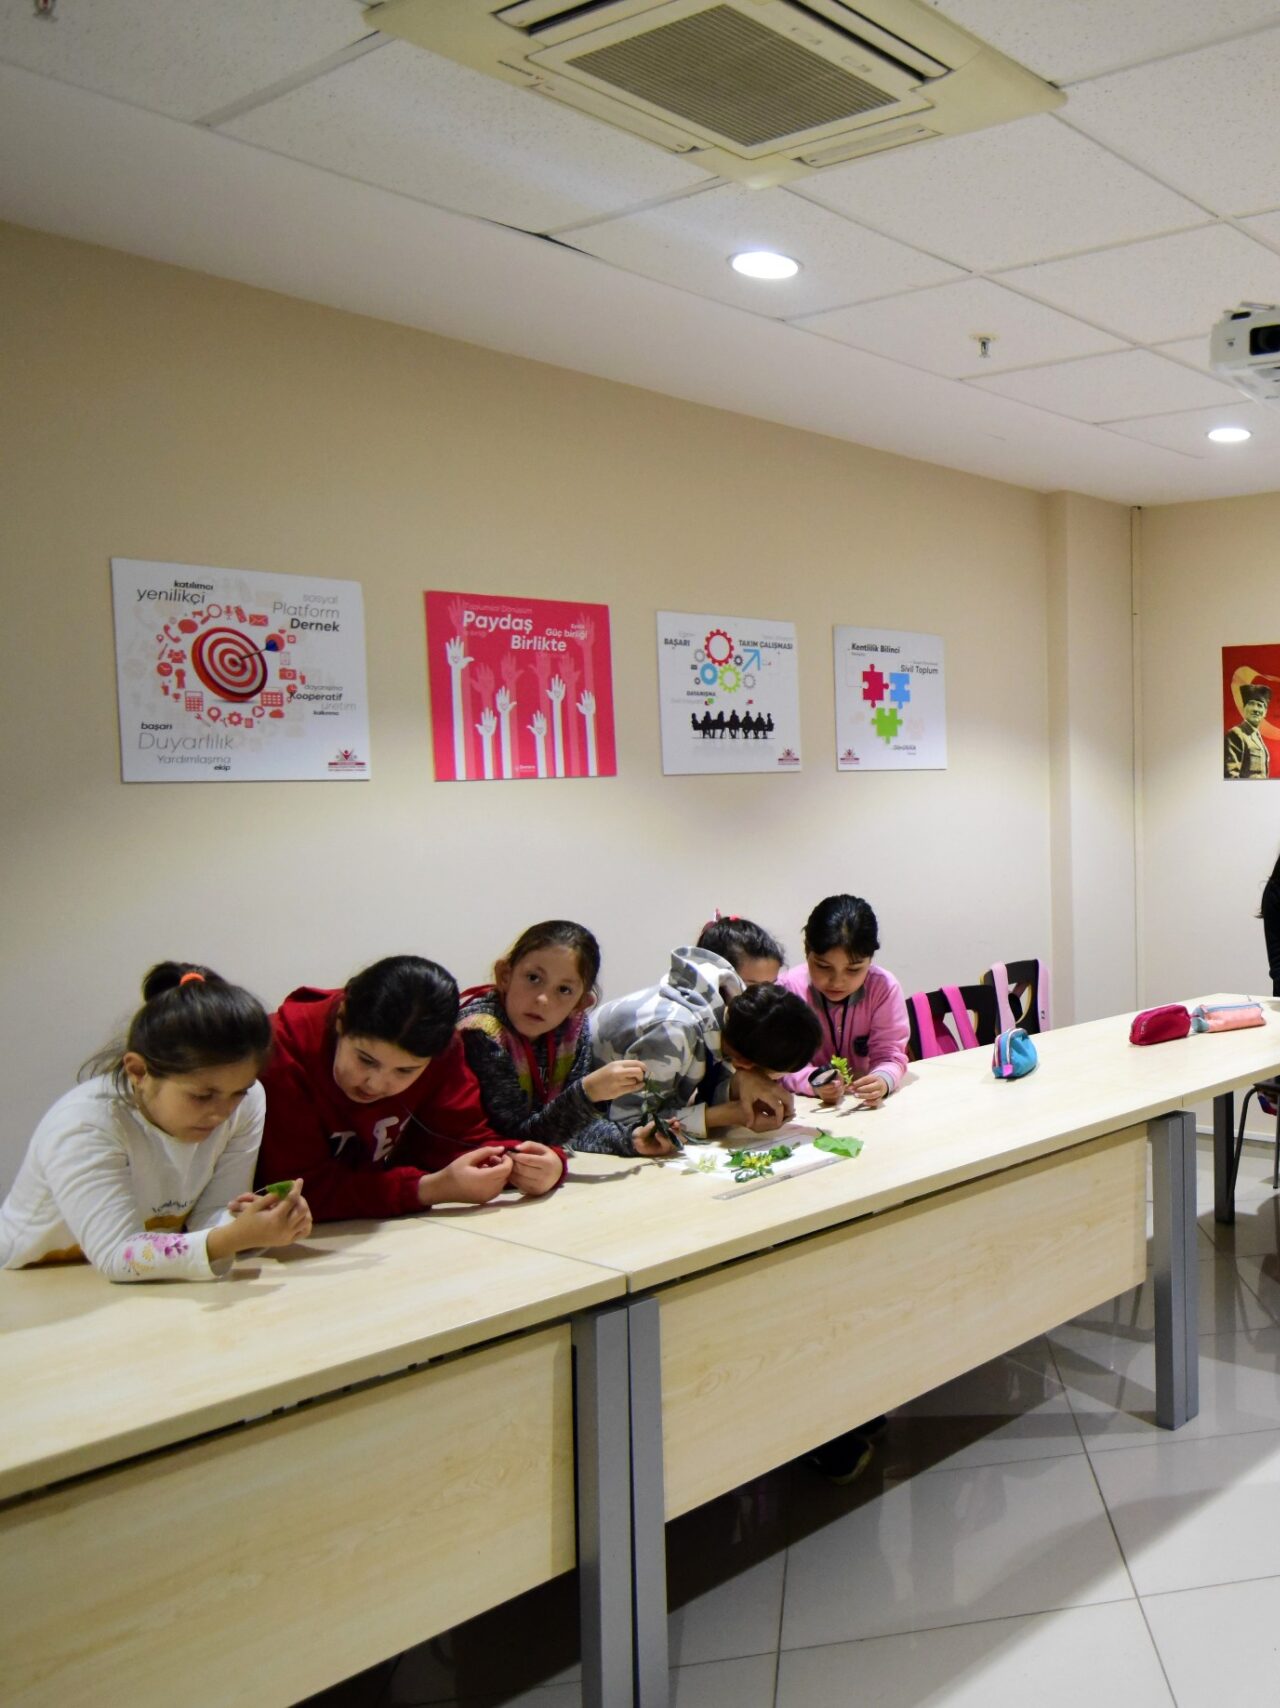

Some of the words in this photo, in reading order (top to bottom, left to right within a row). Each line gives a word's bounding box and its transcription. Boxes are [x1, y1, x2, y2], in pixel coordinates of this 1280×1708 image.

[137, 588, 206, 605] yenilikçi
[273, 601, 340, 618] Platform
[290, 618, 340, 632] Dernek
[463, 610, 534, 635] Paydaş
[545, 628, 562, 638] Güç
[511, 635, 567, 651] Birlikte
[664, 638, 690, 647] BAŞARI
[739, 639, 759, 647] TAKIM
[916, 666, 938, 675] Toplum
[290, 691, 343, 701] Kooperatif
[141, 722, 173, 731] başarı
[138, 732, 234, 753] Duyarlılık
